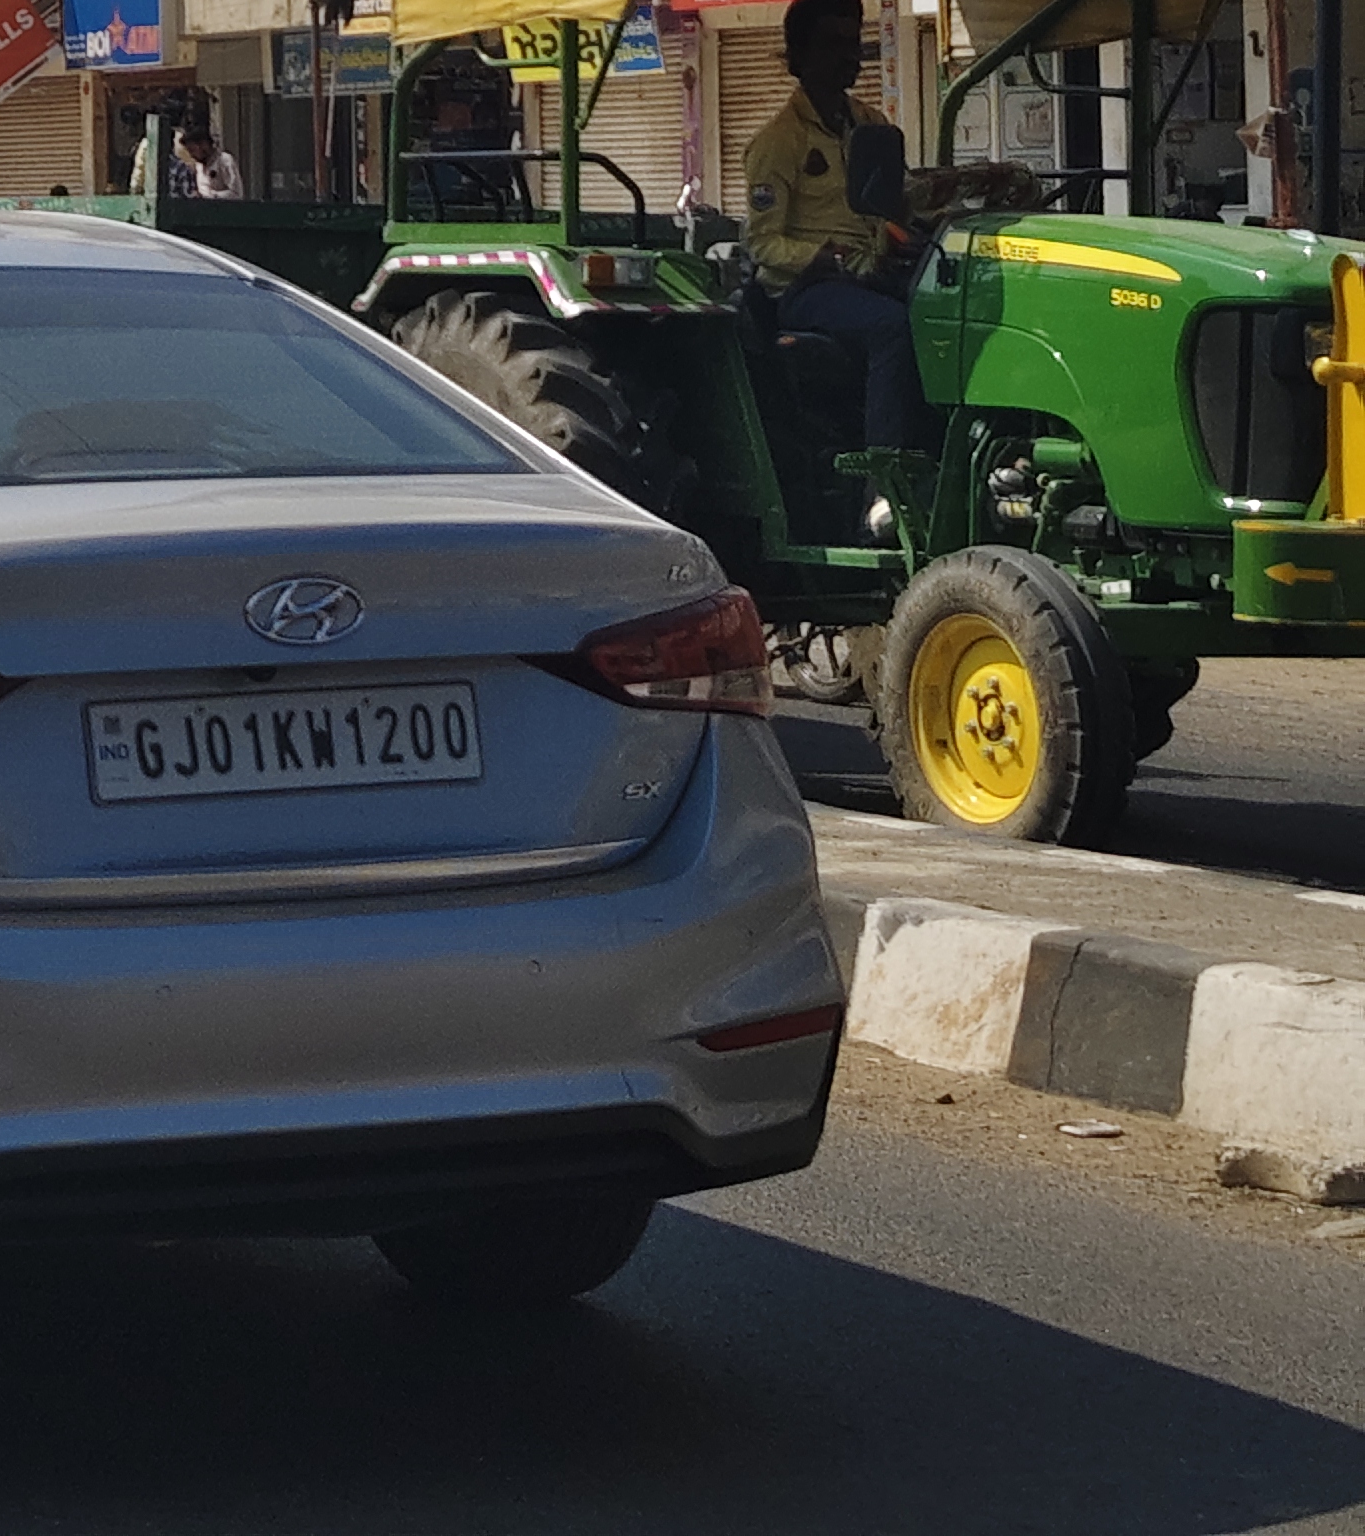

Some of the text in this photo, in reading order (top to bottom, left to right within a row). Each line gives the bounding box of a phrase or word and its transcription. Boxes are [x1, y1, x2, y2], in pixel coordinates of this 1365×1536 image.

[86, 30, 111, 58] BOI
[1110, 287, 1162, 310] 5036 D
[98, 744, 131, 762] IND
[133, 699, 470, 784] GJ01KW1200
[622, 781, 662, 802] SX
